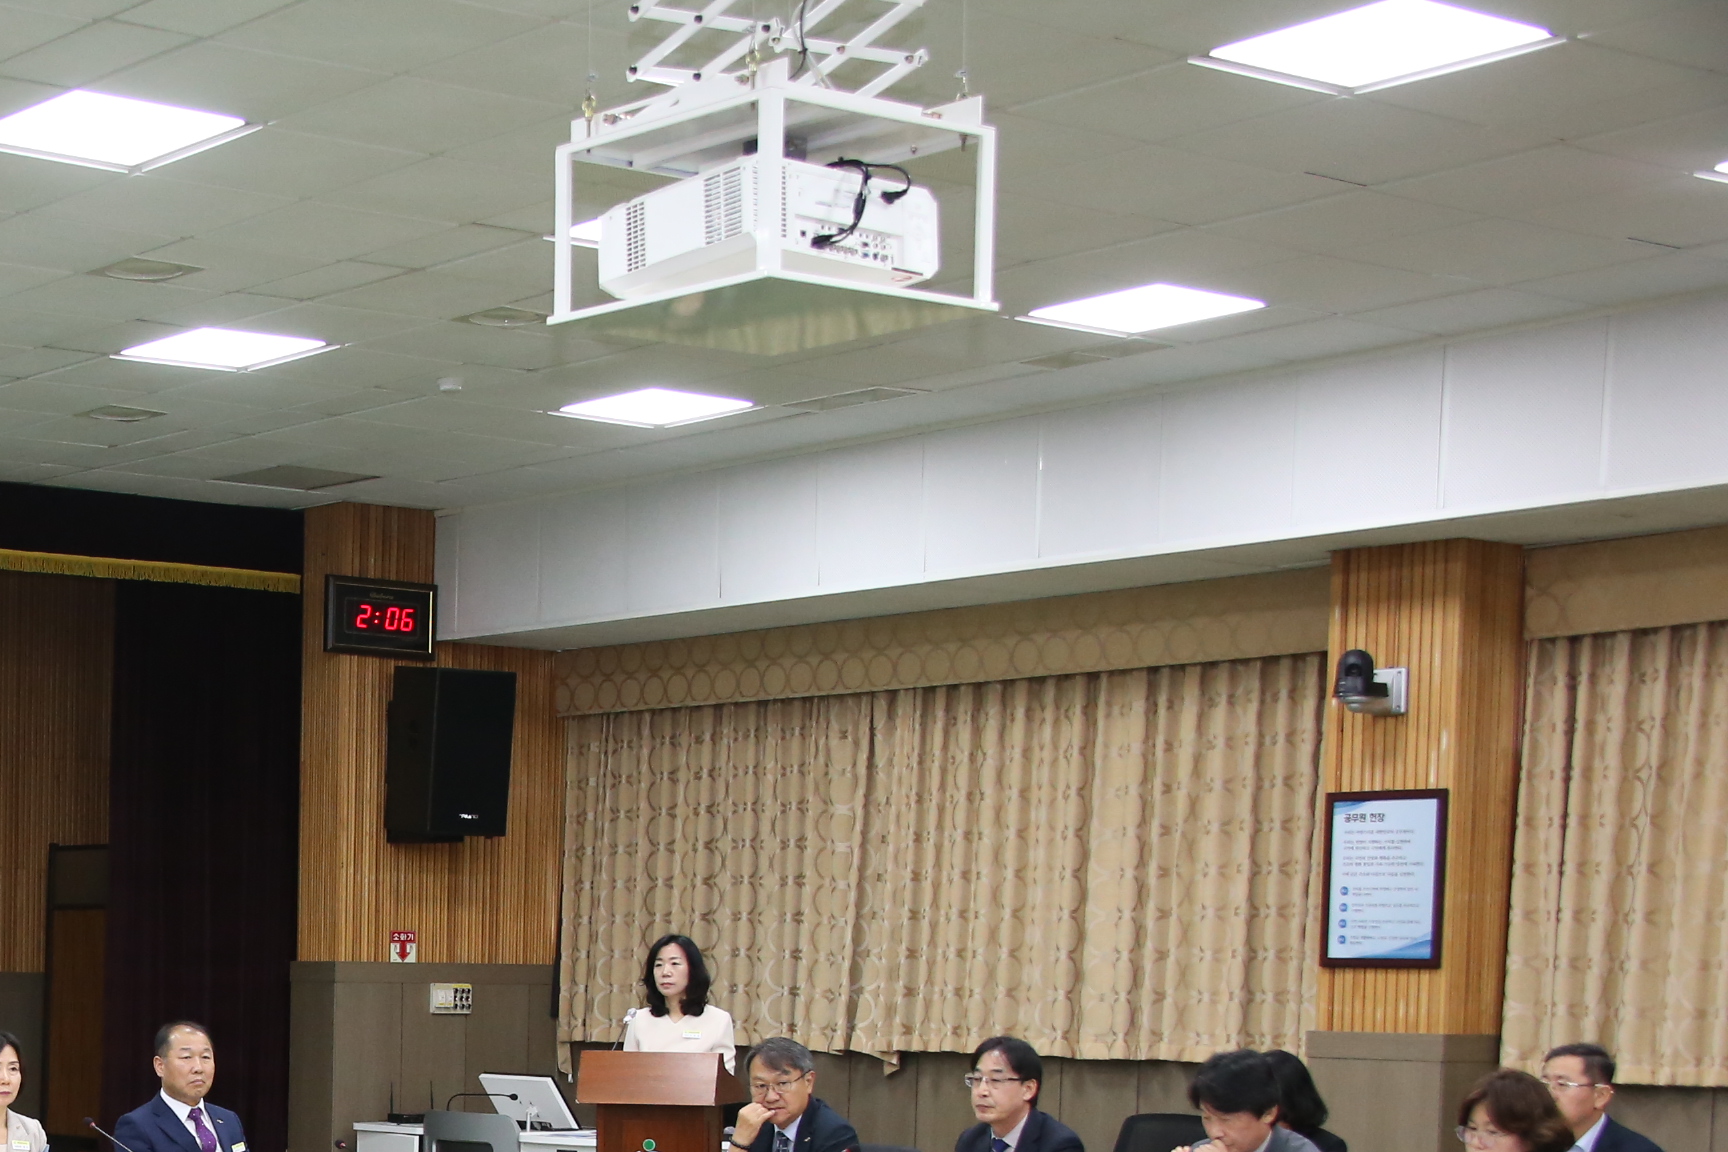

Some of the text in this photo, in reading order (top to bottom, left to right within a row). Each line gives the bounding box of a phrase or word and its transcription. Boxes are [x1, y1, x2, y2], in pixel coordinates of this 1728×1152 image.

[356, 604, 415, 631] 2:06
[1343, 813, 1367, 823] 공무원
[393, 933, 414, 941] 소화기
